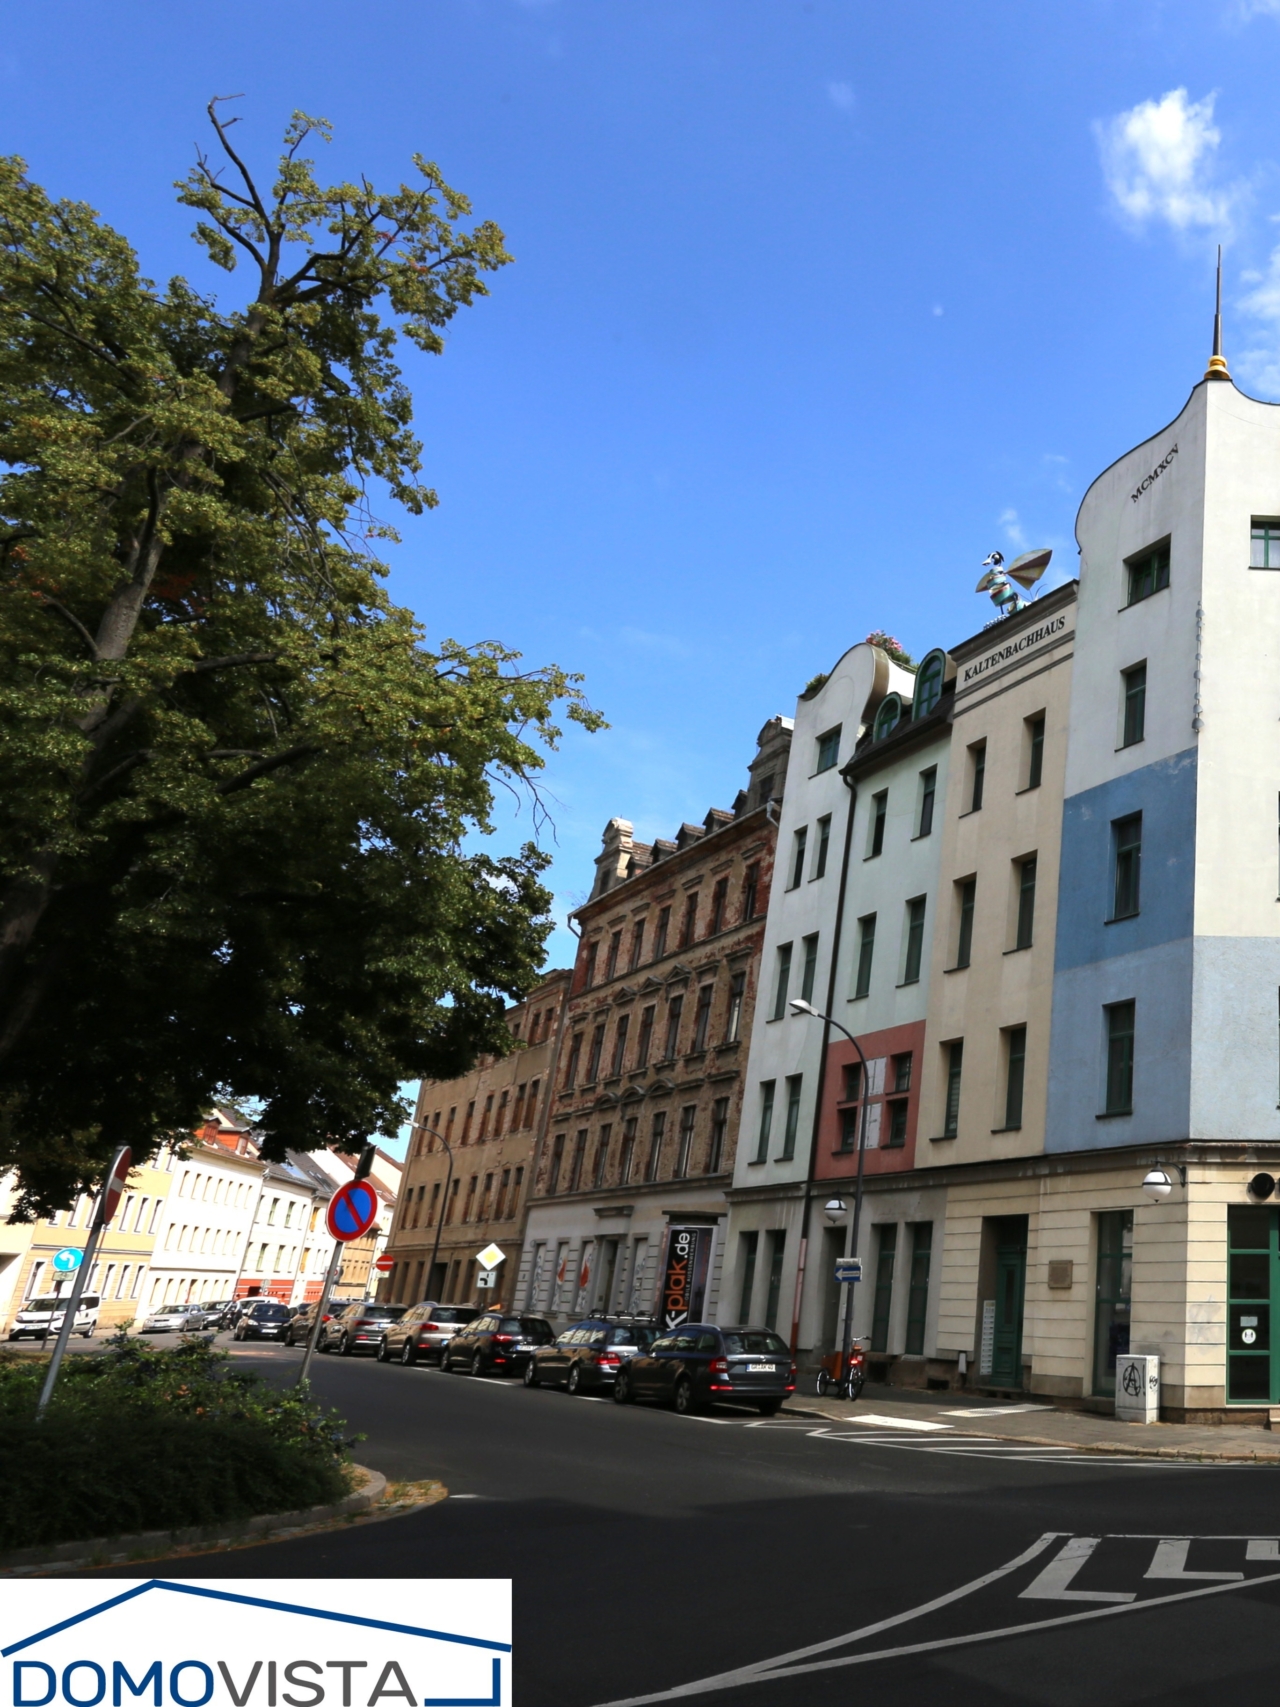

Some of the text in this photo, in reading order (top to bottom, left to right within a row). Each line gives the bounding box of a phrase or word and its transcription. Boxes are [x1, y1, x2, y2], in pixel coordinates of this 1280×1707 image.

[1131, 443, 1179, 504] MCMXCV
[963, 616, 1066, 683] KALTENBACHHAUS
[686, 1232, 697, 1283] AUSSENWERBUNG
